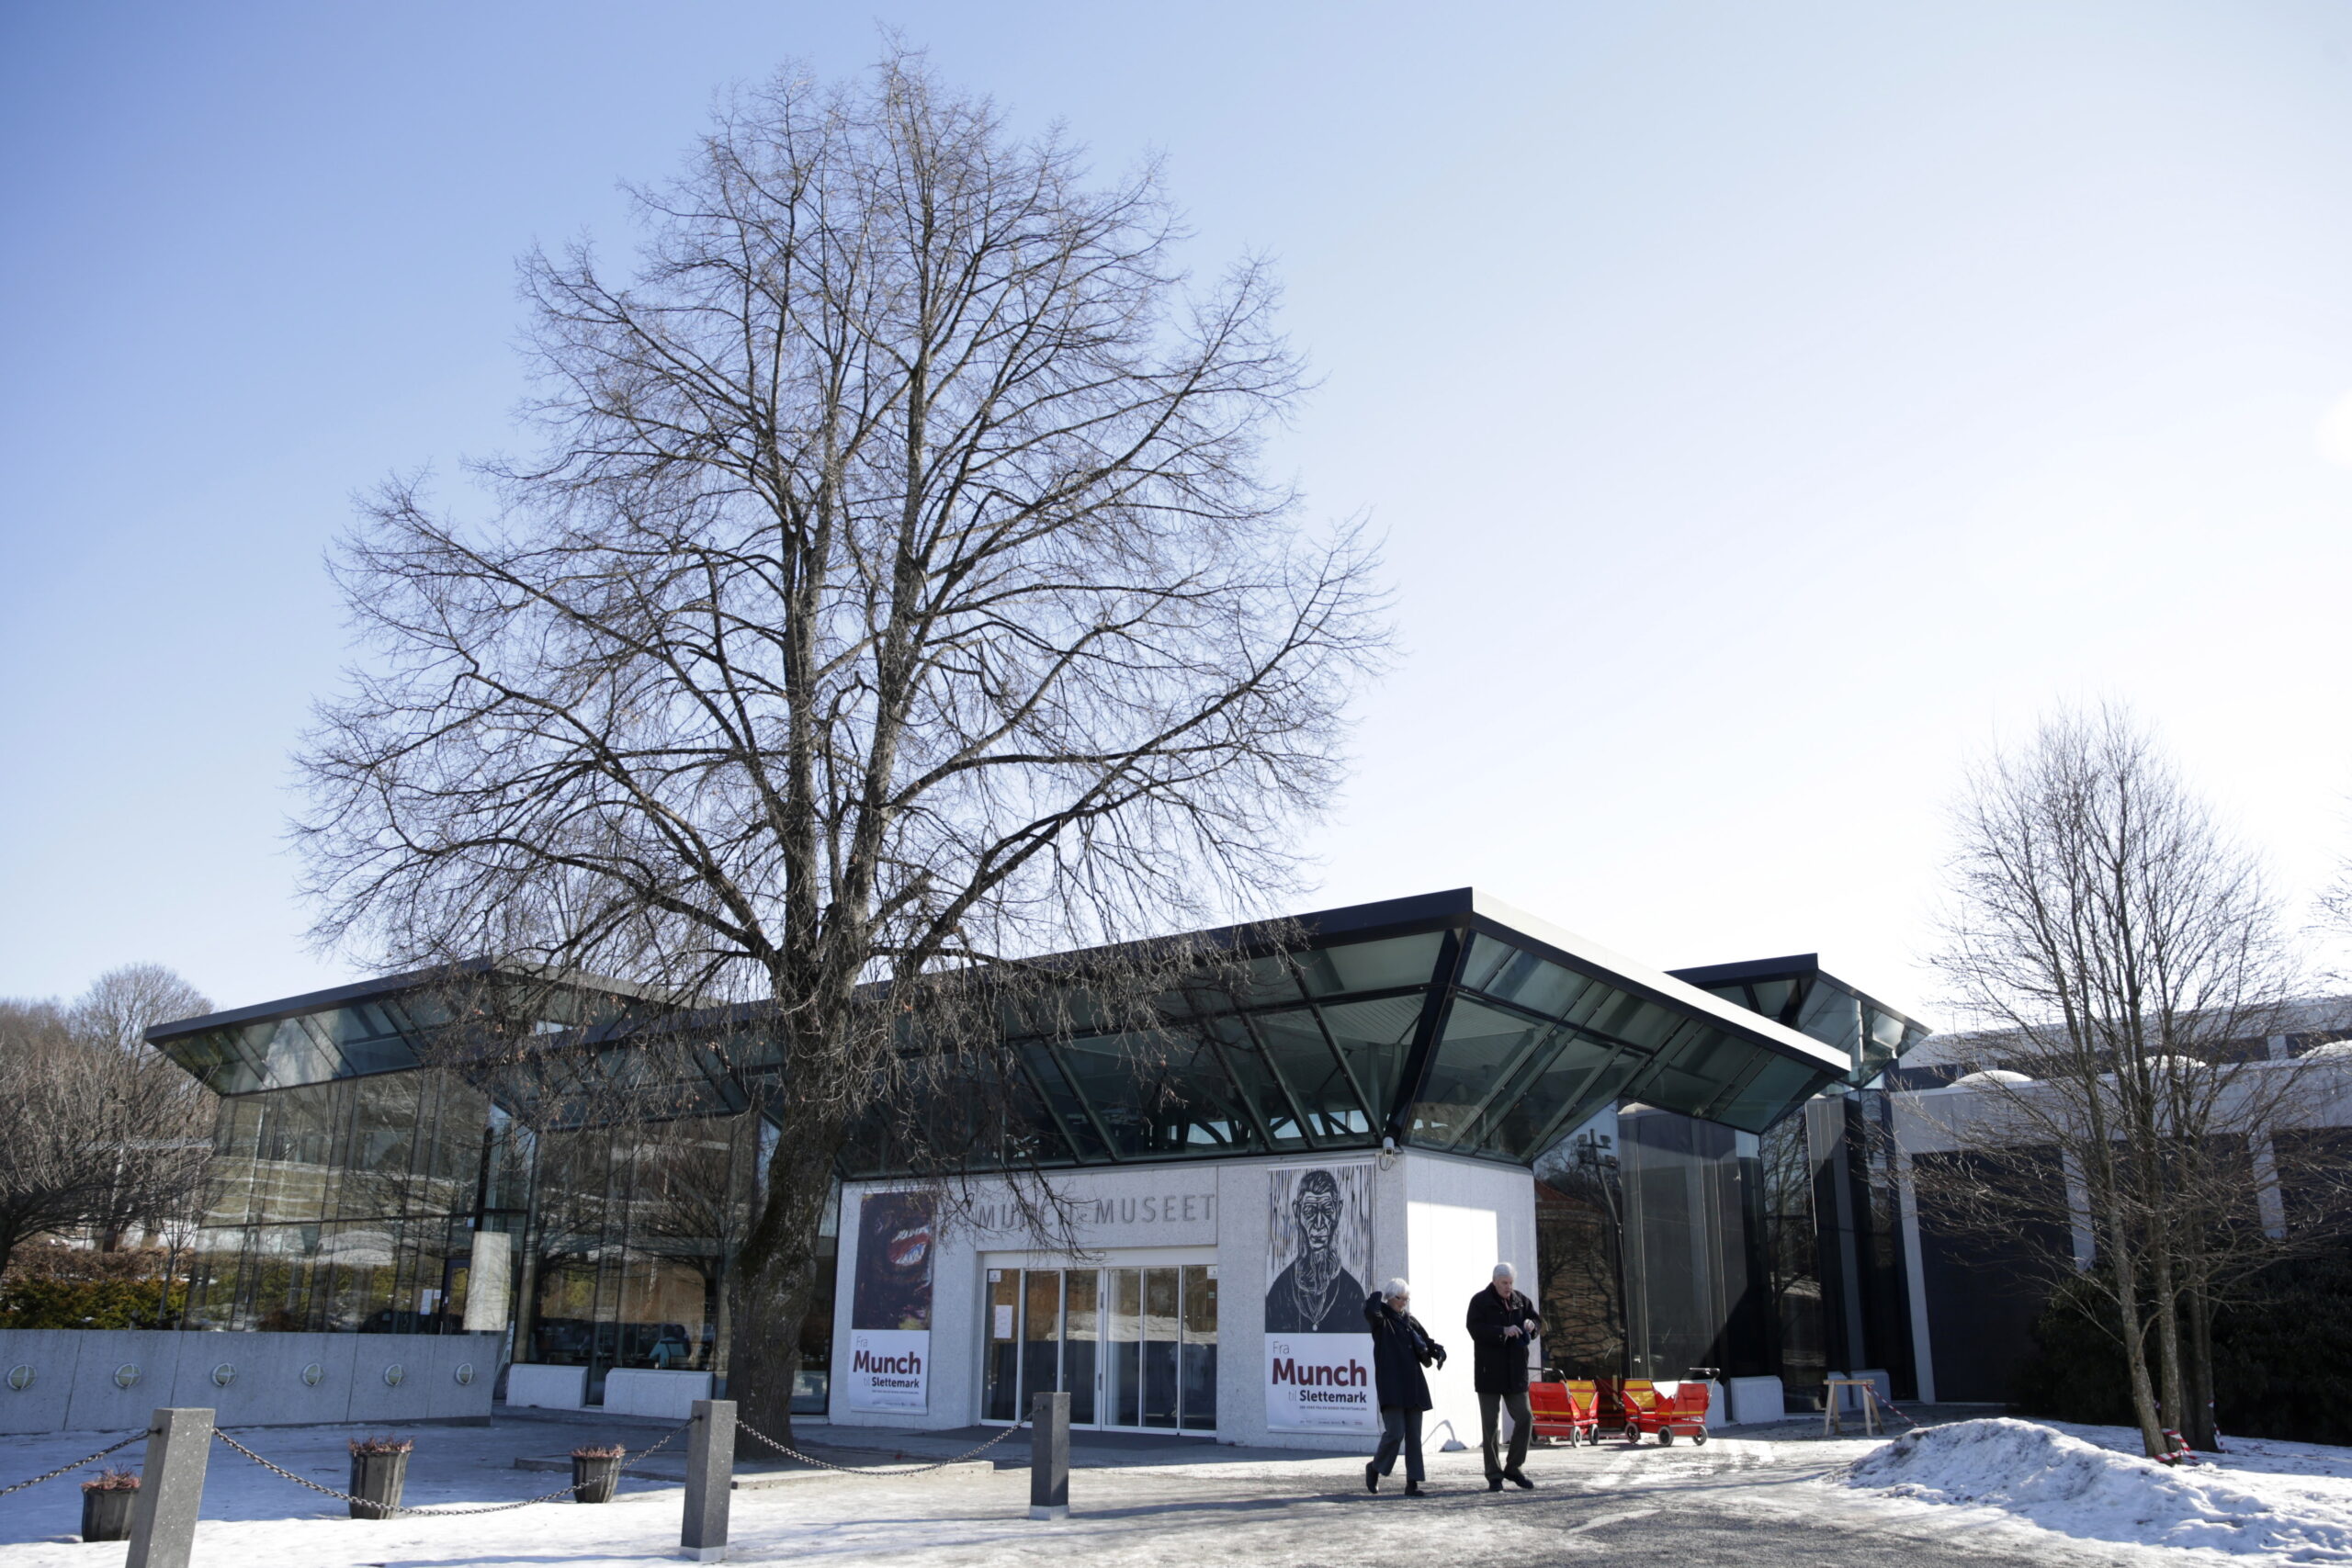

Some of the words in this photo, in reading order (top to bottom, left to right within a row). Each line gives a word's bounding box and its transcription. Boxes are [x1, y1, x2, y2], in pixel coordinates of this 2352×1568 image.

[1094, 1194, 1216, 1224] MUSEET
[1272, 1340, 1290, 1355] Fra
[853, 1350, 921, 1374] Munch
[1272, 1358, 1367, 1386] Munch
[872, 1377, 920, 1388] Slettemark
[1288, 1390, 1297, 1402] til
[1299, 1390, 1367, 1403] Slettemark
